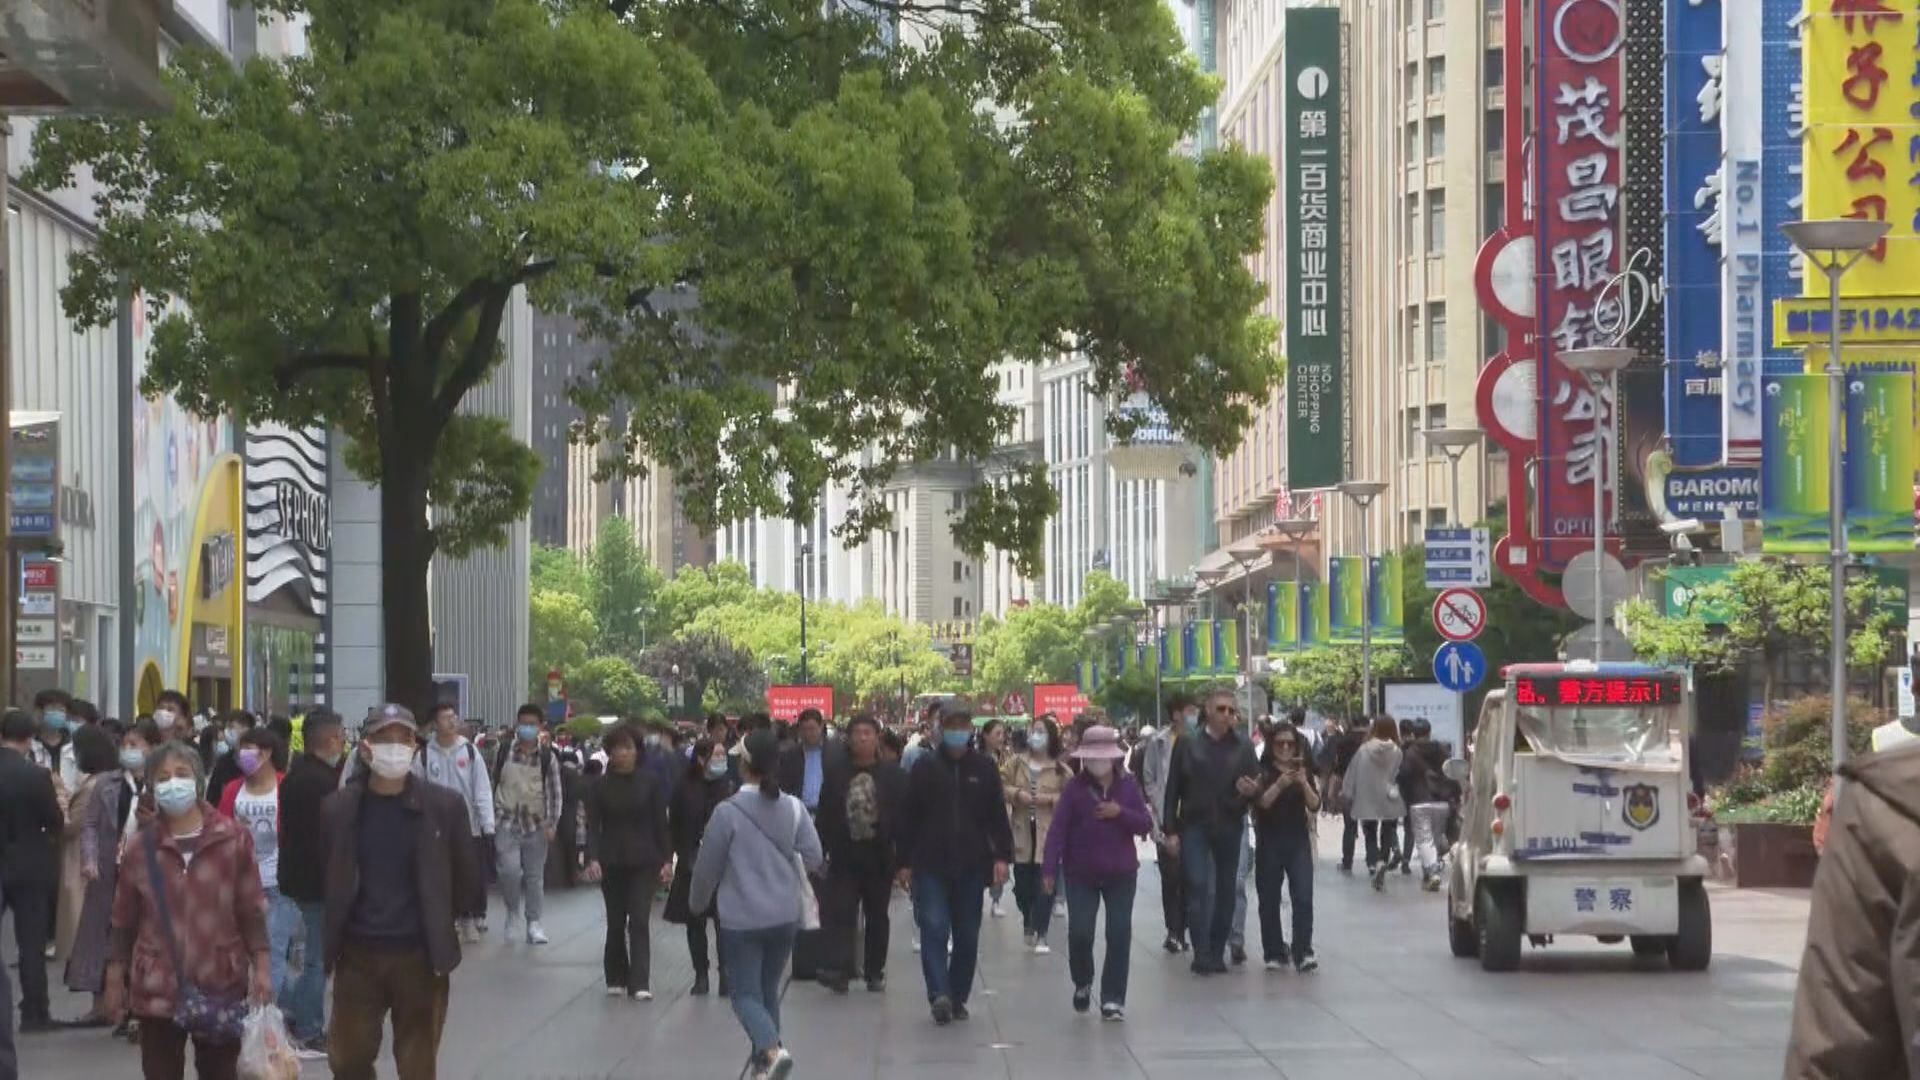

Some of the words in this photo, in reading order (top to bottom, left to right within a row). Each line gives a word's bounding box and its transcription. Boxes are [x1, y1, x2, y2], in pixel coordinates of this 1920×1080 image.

[1300, 110, 1327, 336] 第一百货商业中心
[1736, 160, 1759, 237] No.1
[1731, 254, 1759, 416] Pharmacy
[1787, 307, 1920, 333] 于1942
[1298, 365, 1308, 418] CENTER
[1309, 365, 1320, 433] SHOPPING
[278, 481, 332, 549] SEPHORA
[1554, 517, 1625, 535] OPTIA
[1575, 887, 1632, 911] 警察
